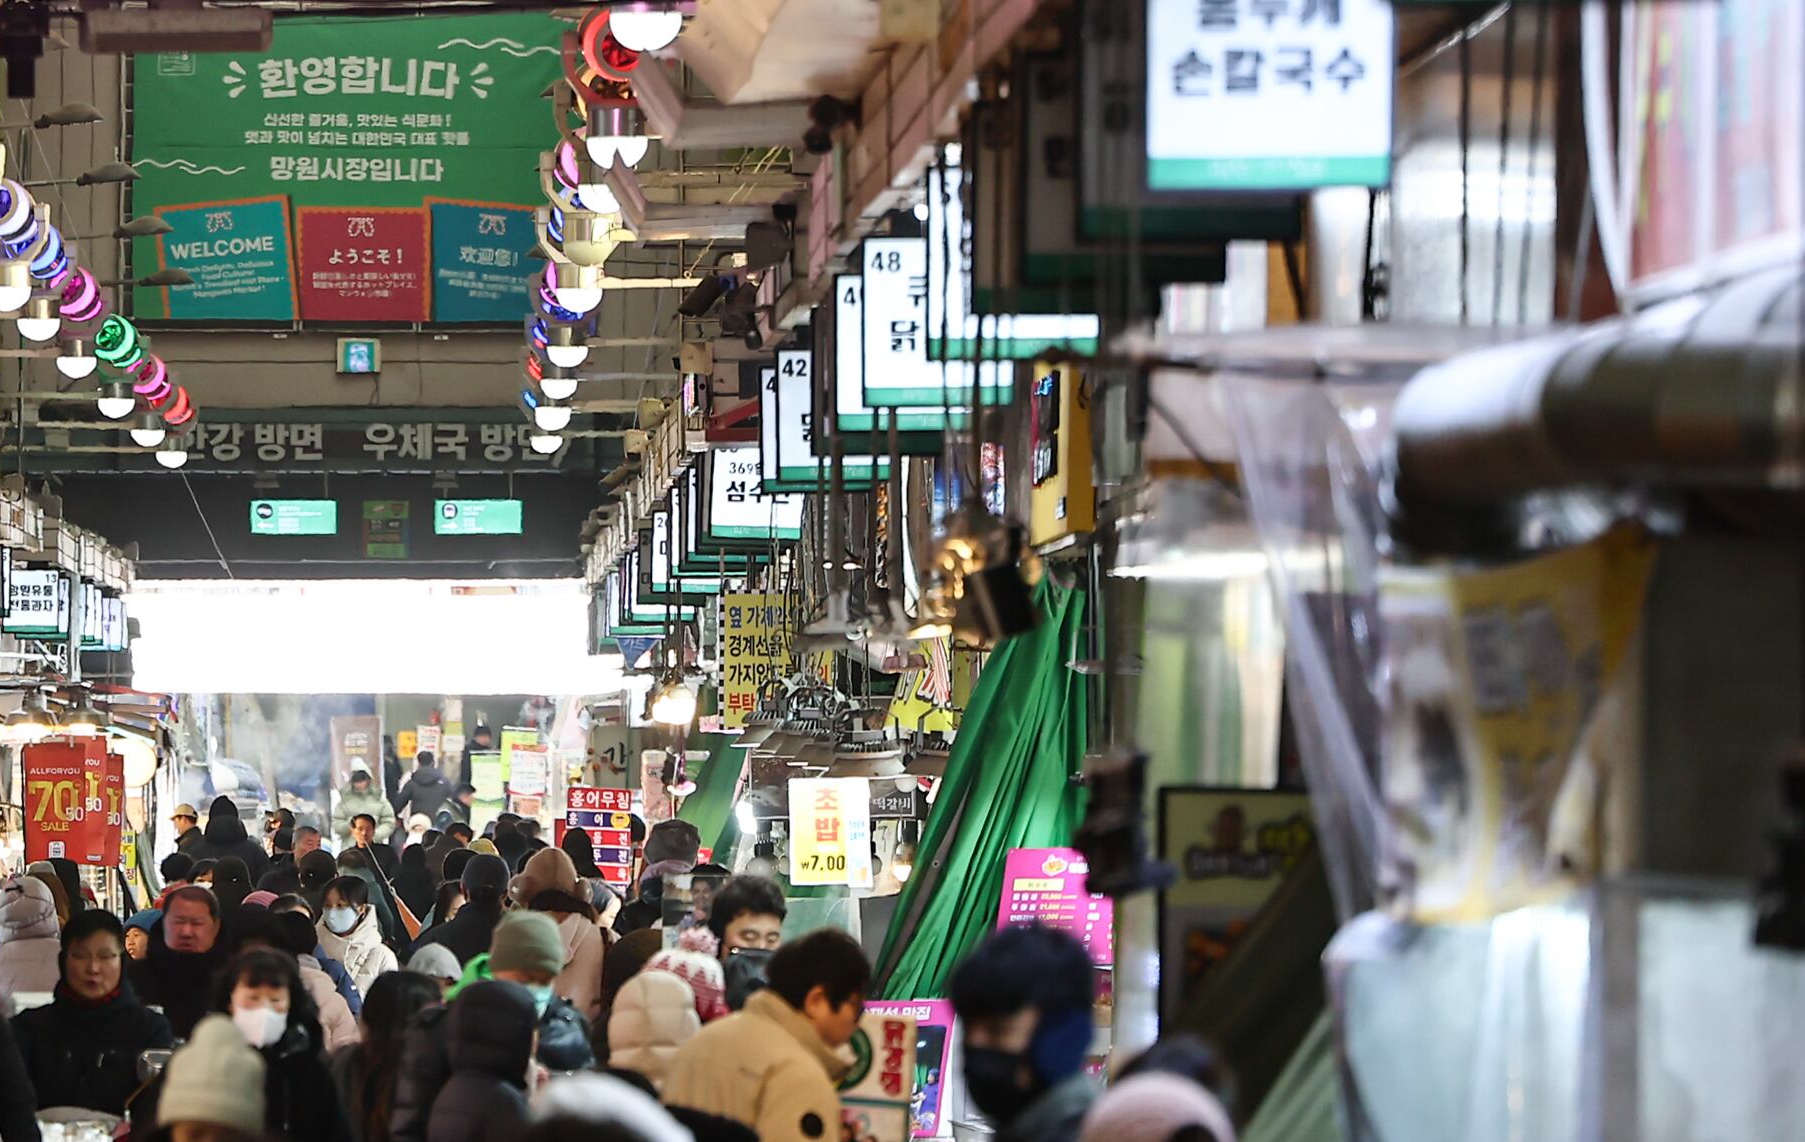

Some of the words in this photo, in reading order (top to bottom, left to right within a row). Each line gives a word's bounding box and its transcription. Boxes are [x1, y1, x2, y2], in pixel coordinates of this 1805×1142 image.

[257, 56, 461, 100] 환영합니다
[1172, 47, 1366, 97] 손칼국수
[263, 113, 305, 127] 신선한
[308, 113, 353, 127] 즐거움,
[356, 113, 398, 127] 맛있는
[244, 130, 274, 144] 멋과
[277, 130, 304, 145] 맛이
[307, 131, 348, 145] 넘치는
[351, 132, 407, 146] 대한민국
[410, 132, 438, 146] 대표
[269, 155, 445, 182] 망원시장입니다
[170, 236, 274, 260] WELCOME
[871, 251, 901, 272] 48
[890, 320, 920, 351] 닭
[782, 359, 808, 378] 42
[254, 422, 324, 461] 방면
[362, 422, 469, 462] 우체국
[45, 573, 58, 583] 13
[729, 606, 742, 629] 옆
[728, 634, 783, 658] 경계선을
[727, 692, 756, 716] 부탁
[30, 767, 81, 776] ALLFORYOU
[569, 789, 630, 810] 홍어무침
[814, 786, 841, 843] 초밥
[40, 822, 70, 832] SALE
